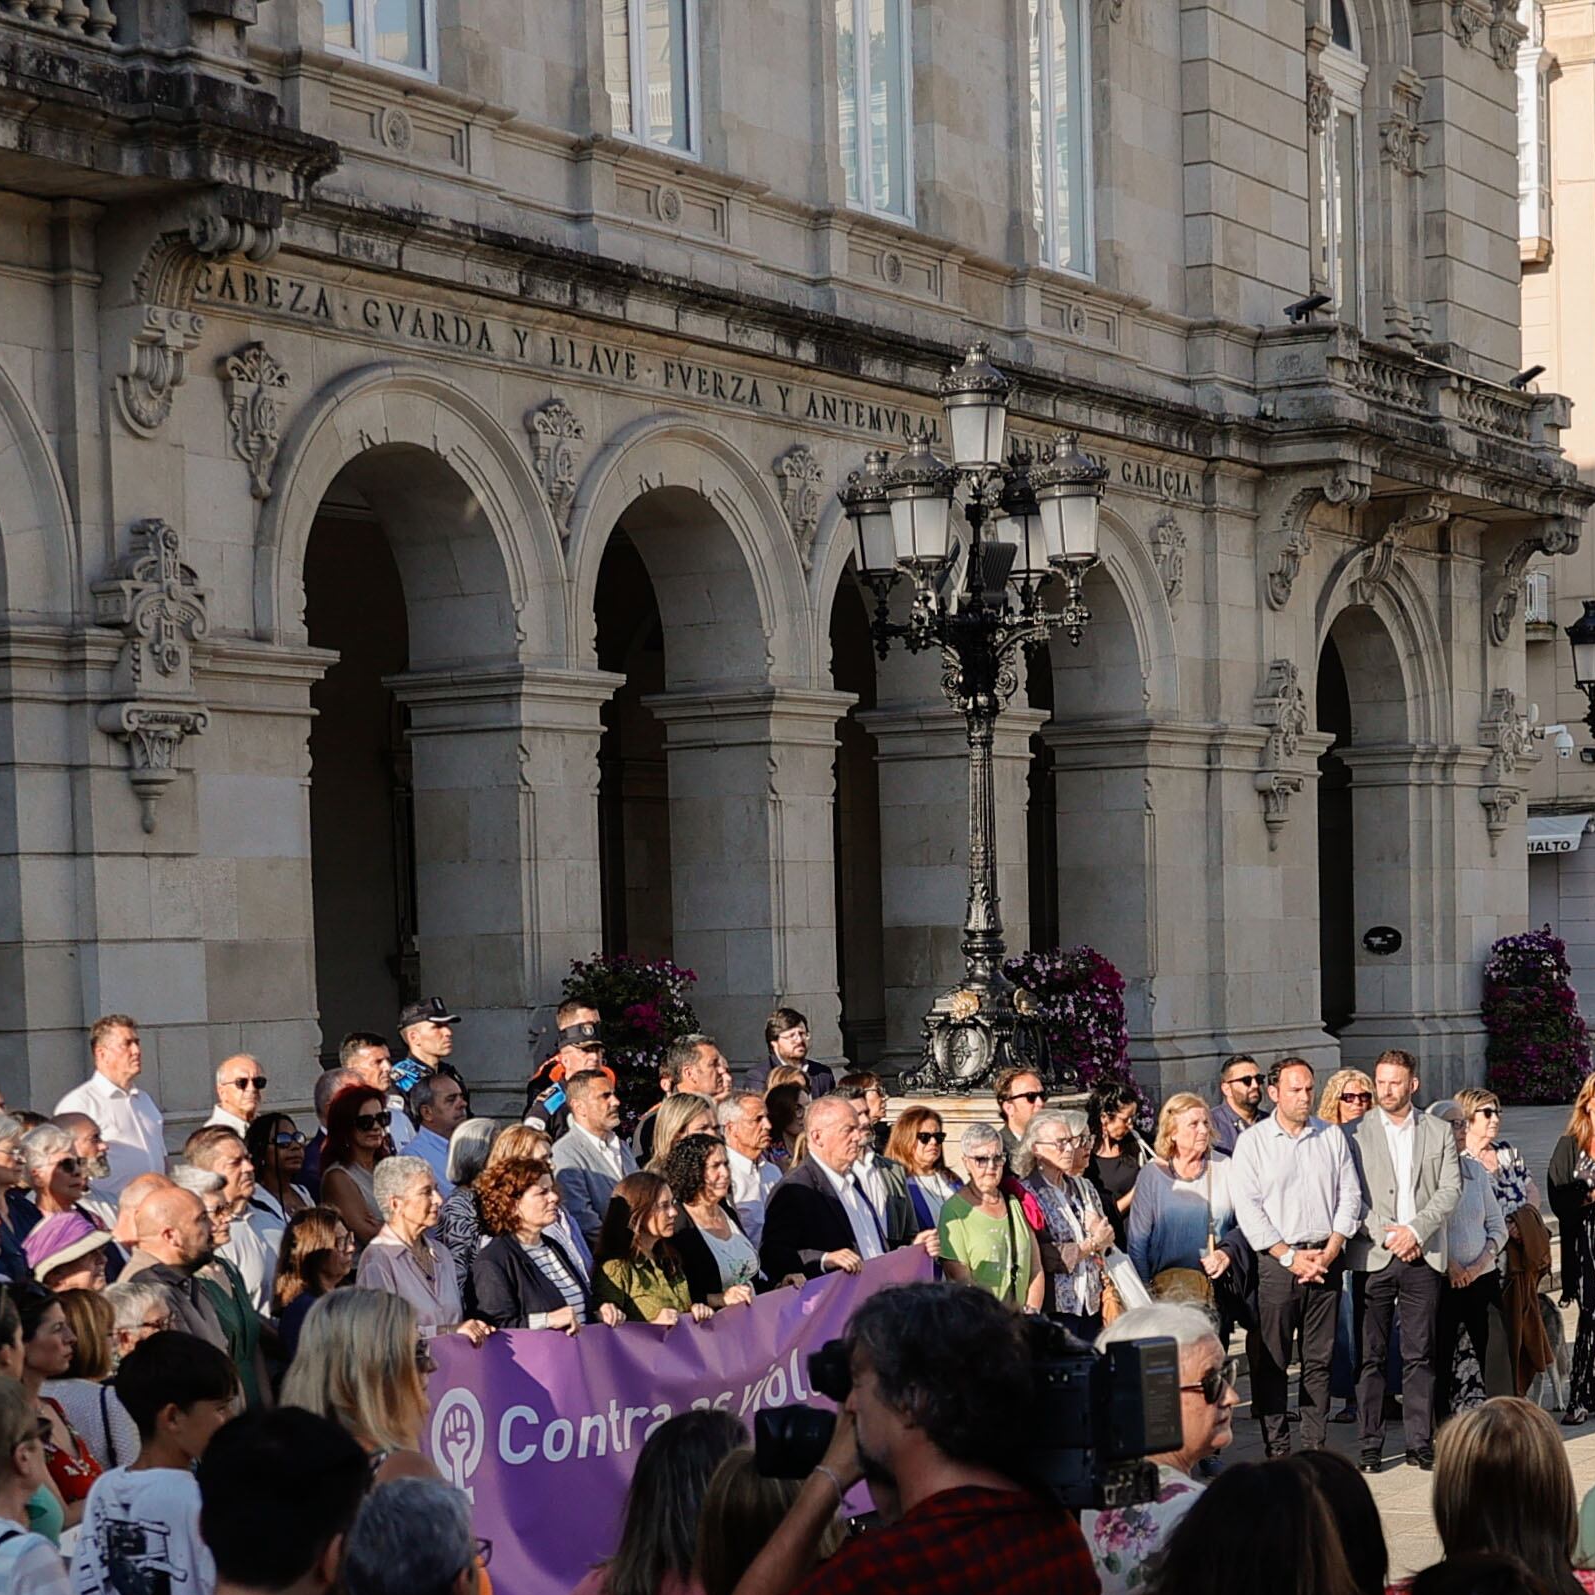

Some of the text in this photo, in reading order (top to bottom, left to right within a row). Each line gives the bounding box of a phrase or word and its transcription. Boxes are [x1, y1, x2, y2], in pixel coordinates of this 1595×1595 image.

[363, 299, 494, 352] GVARDA
[513, 328, 529, 358] Y
[550, 336, 638, 381] LLAVE
[663, 360, 763, 408] FVERZA
[777, 385, 791, 412] Y
[1122, 461, 1192, 497] GALICIA
